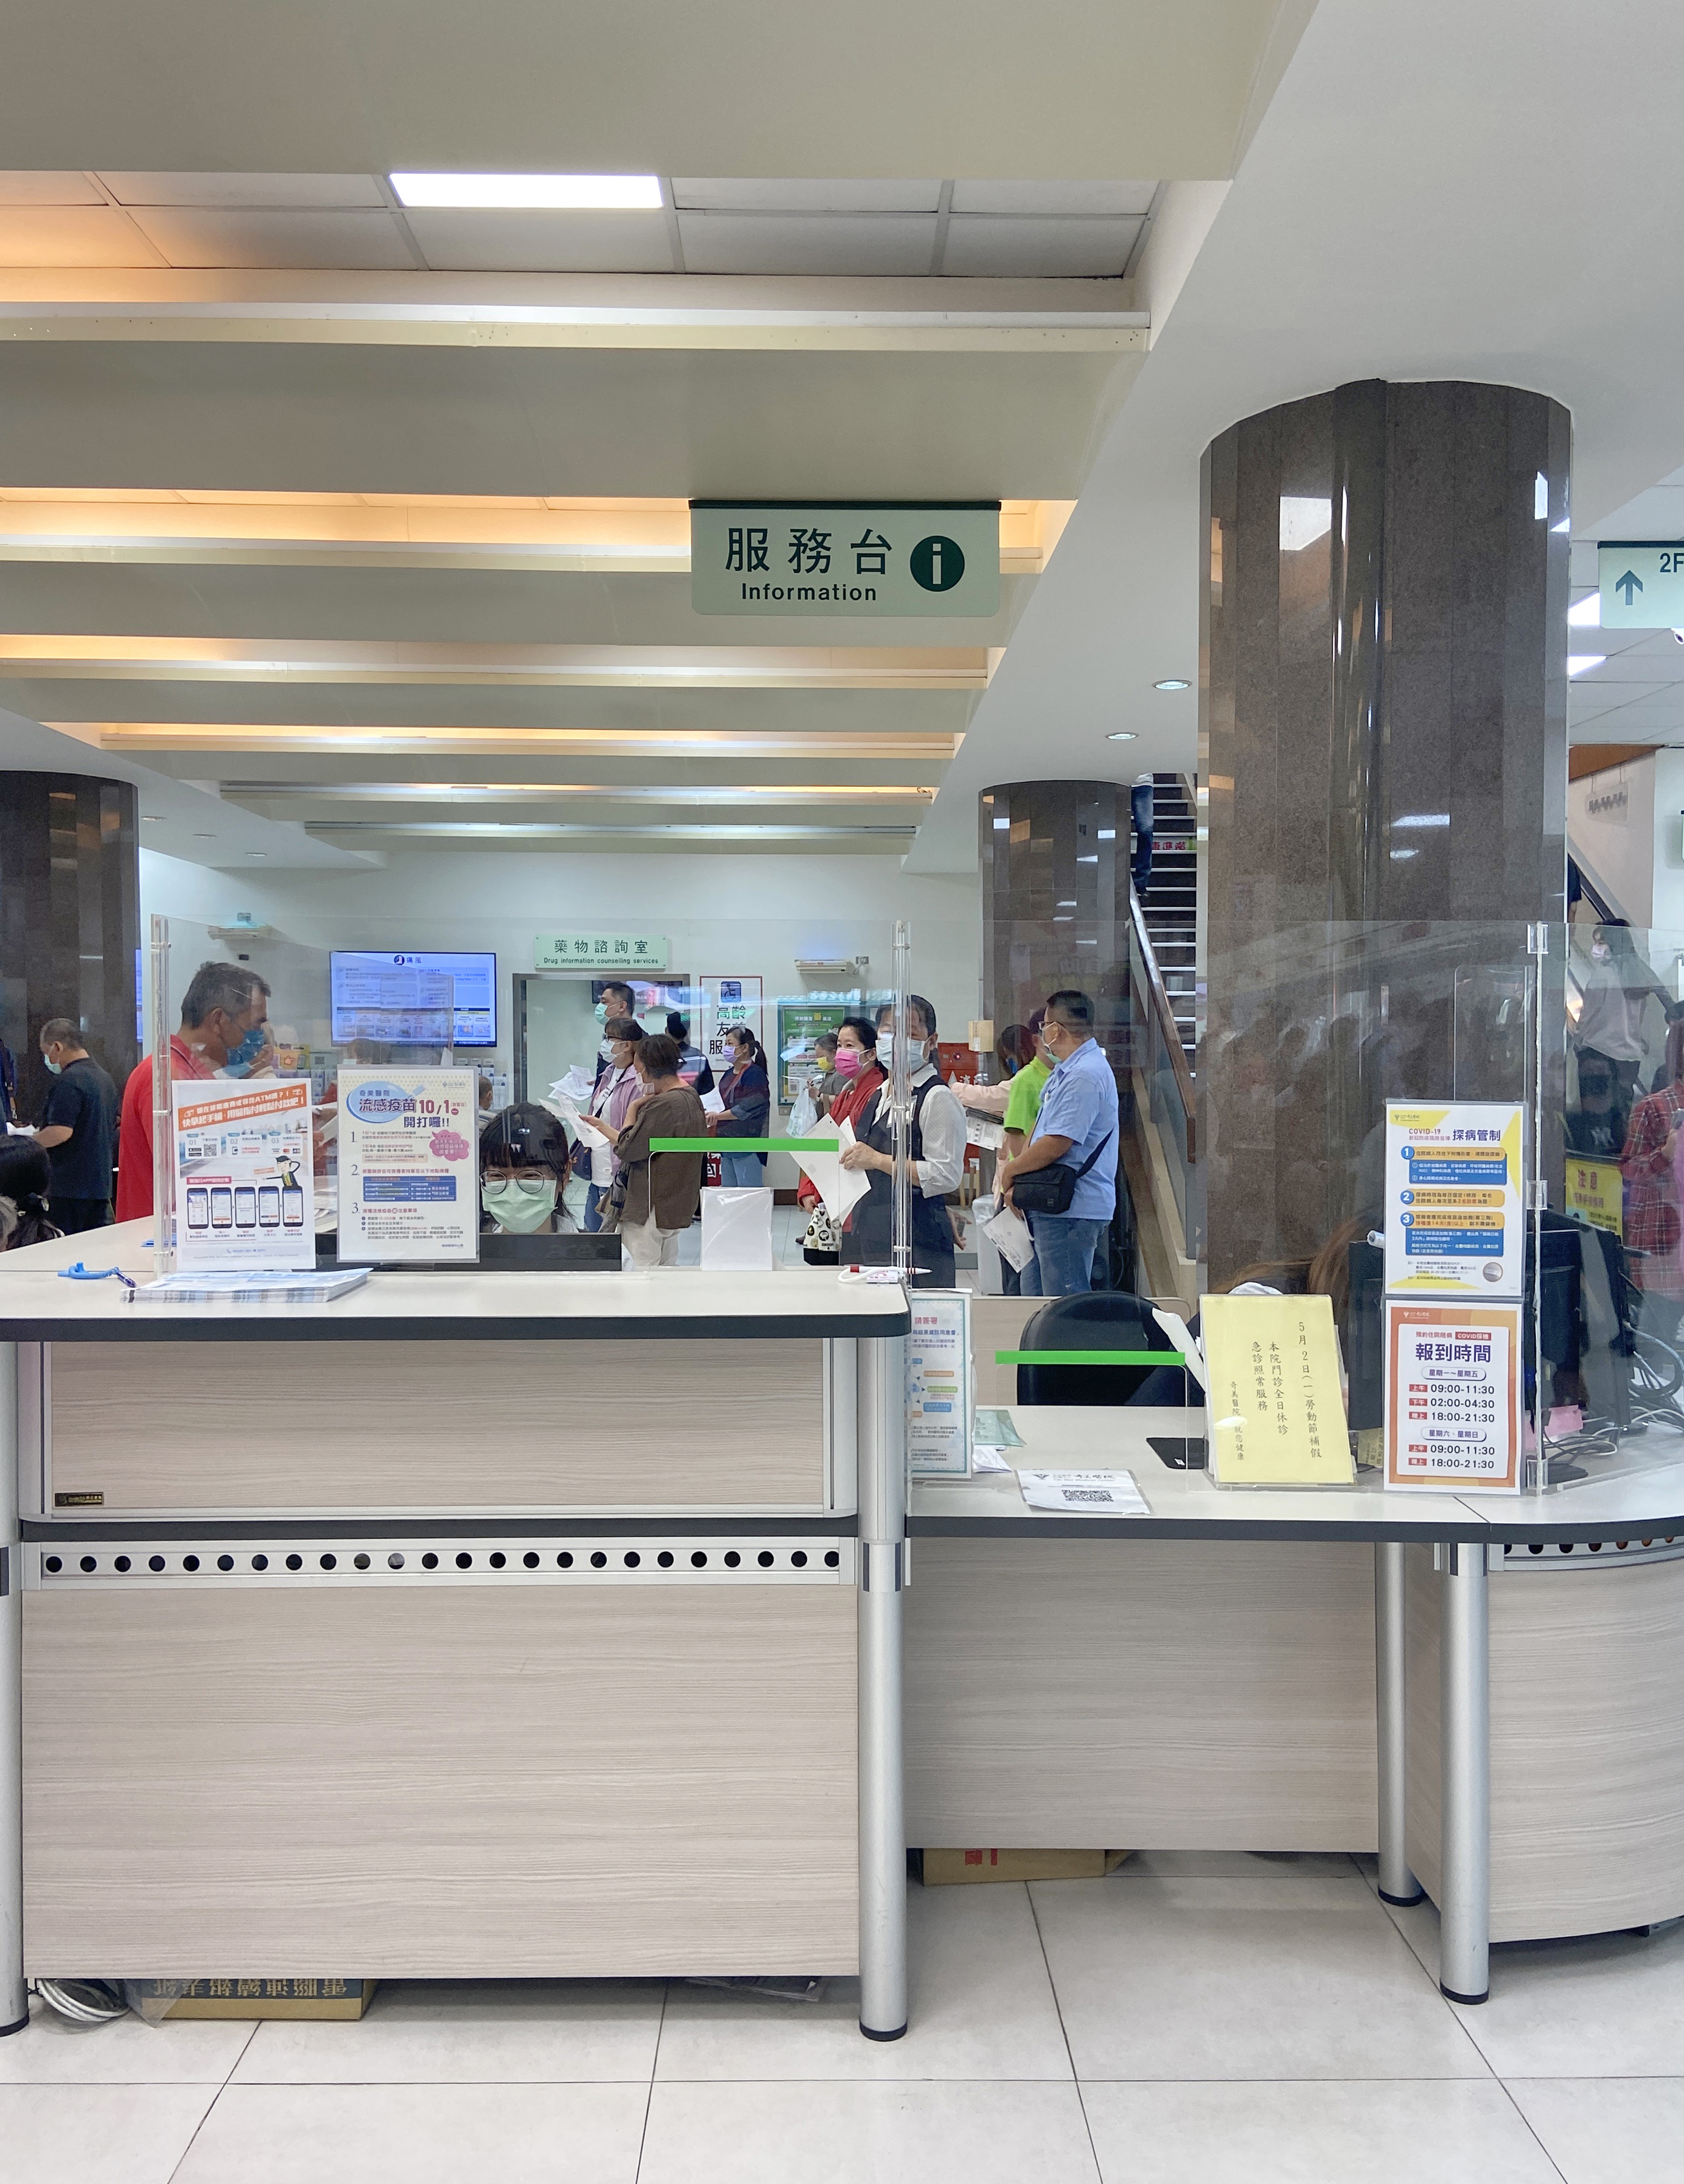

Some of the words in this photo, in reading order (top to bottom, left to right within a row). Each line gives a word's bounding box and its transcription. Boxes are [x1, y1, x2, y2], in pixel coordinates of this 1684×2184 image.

[725, 528, 892, 575] 服務台
[1660, 553, 1684, 572] 2F
[742, 583, 877, 601] Information
[554, 940, 648, 953] 藥物諮詢室
[717, 1005, 746, 1019] 高齡
[717, 1022, 746, 1036] 友
[359, 1098, 416, 1113] 流感疫苗
[419, 1100, 450, 1115] 10/1
[404, 1116, 450, 1128] 開打囉!!
[1452, 1129, 1501, 1141] 探病管制
[1416, 1343, 1491, 1363] 報到時間
[1252, 1342, 1268, 1411] 急診照常服務
[1269, 1342, 1288, 1435] 本院門診全日休診
[1431, 1385, 1494, 1394] 09:00-11:30
[1430, 1398, 1494, 1408] 02:00-04:30
[1431, 1412, 1494, 1423] 18:00-21:30
[1430, 1445, 1495, 1455] 09:00-11:30
[1431, 1458, 1494, 1469] 18:00-21:30
